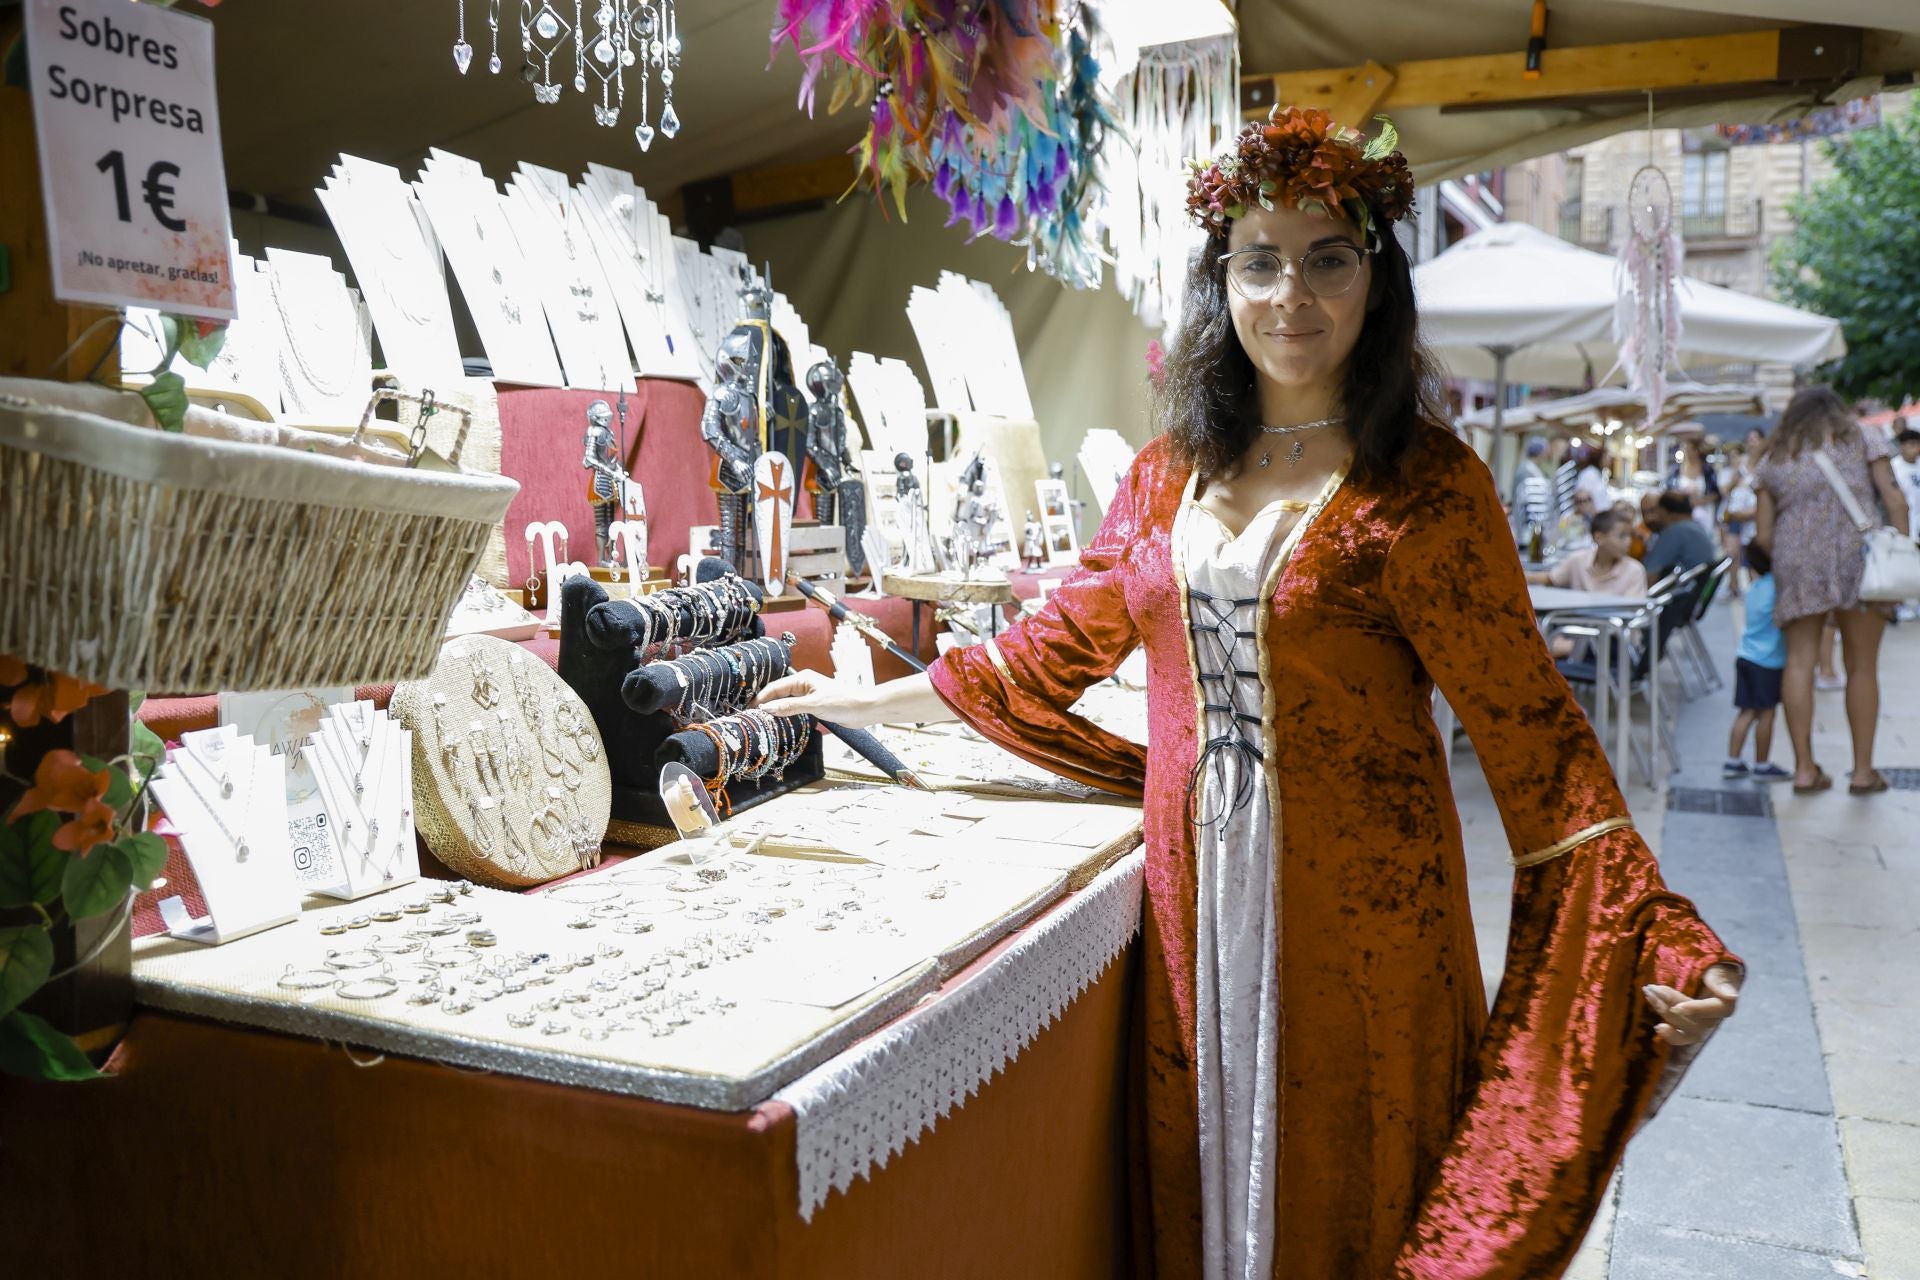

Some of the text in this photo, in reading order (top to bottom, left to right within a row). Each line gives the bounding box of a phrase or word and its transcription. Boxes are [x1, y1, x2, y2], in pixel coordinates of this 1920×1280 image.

[59, 6, 178, 69] Sobres
[48, 64, 204, 134] Sorpresa
[95, 150, 186, 232] 1€
[78, 250, 103, 267] ¡No
[167, 266, 219, 284] gracias!
